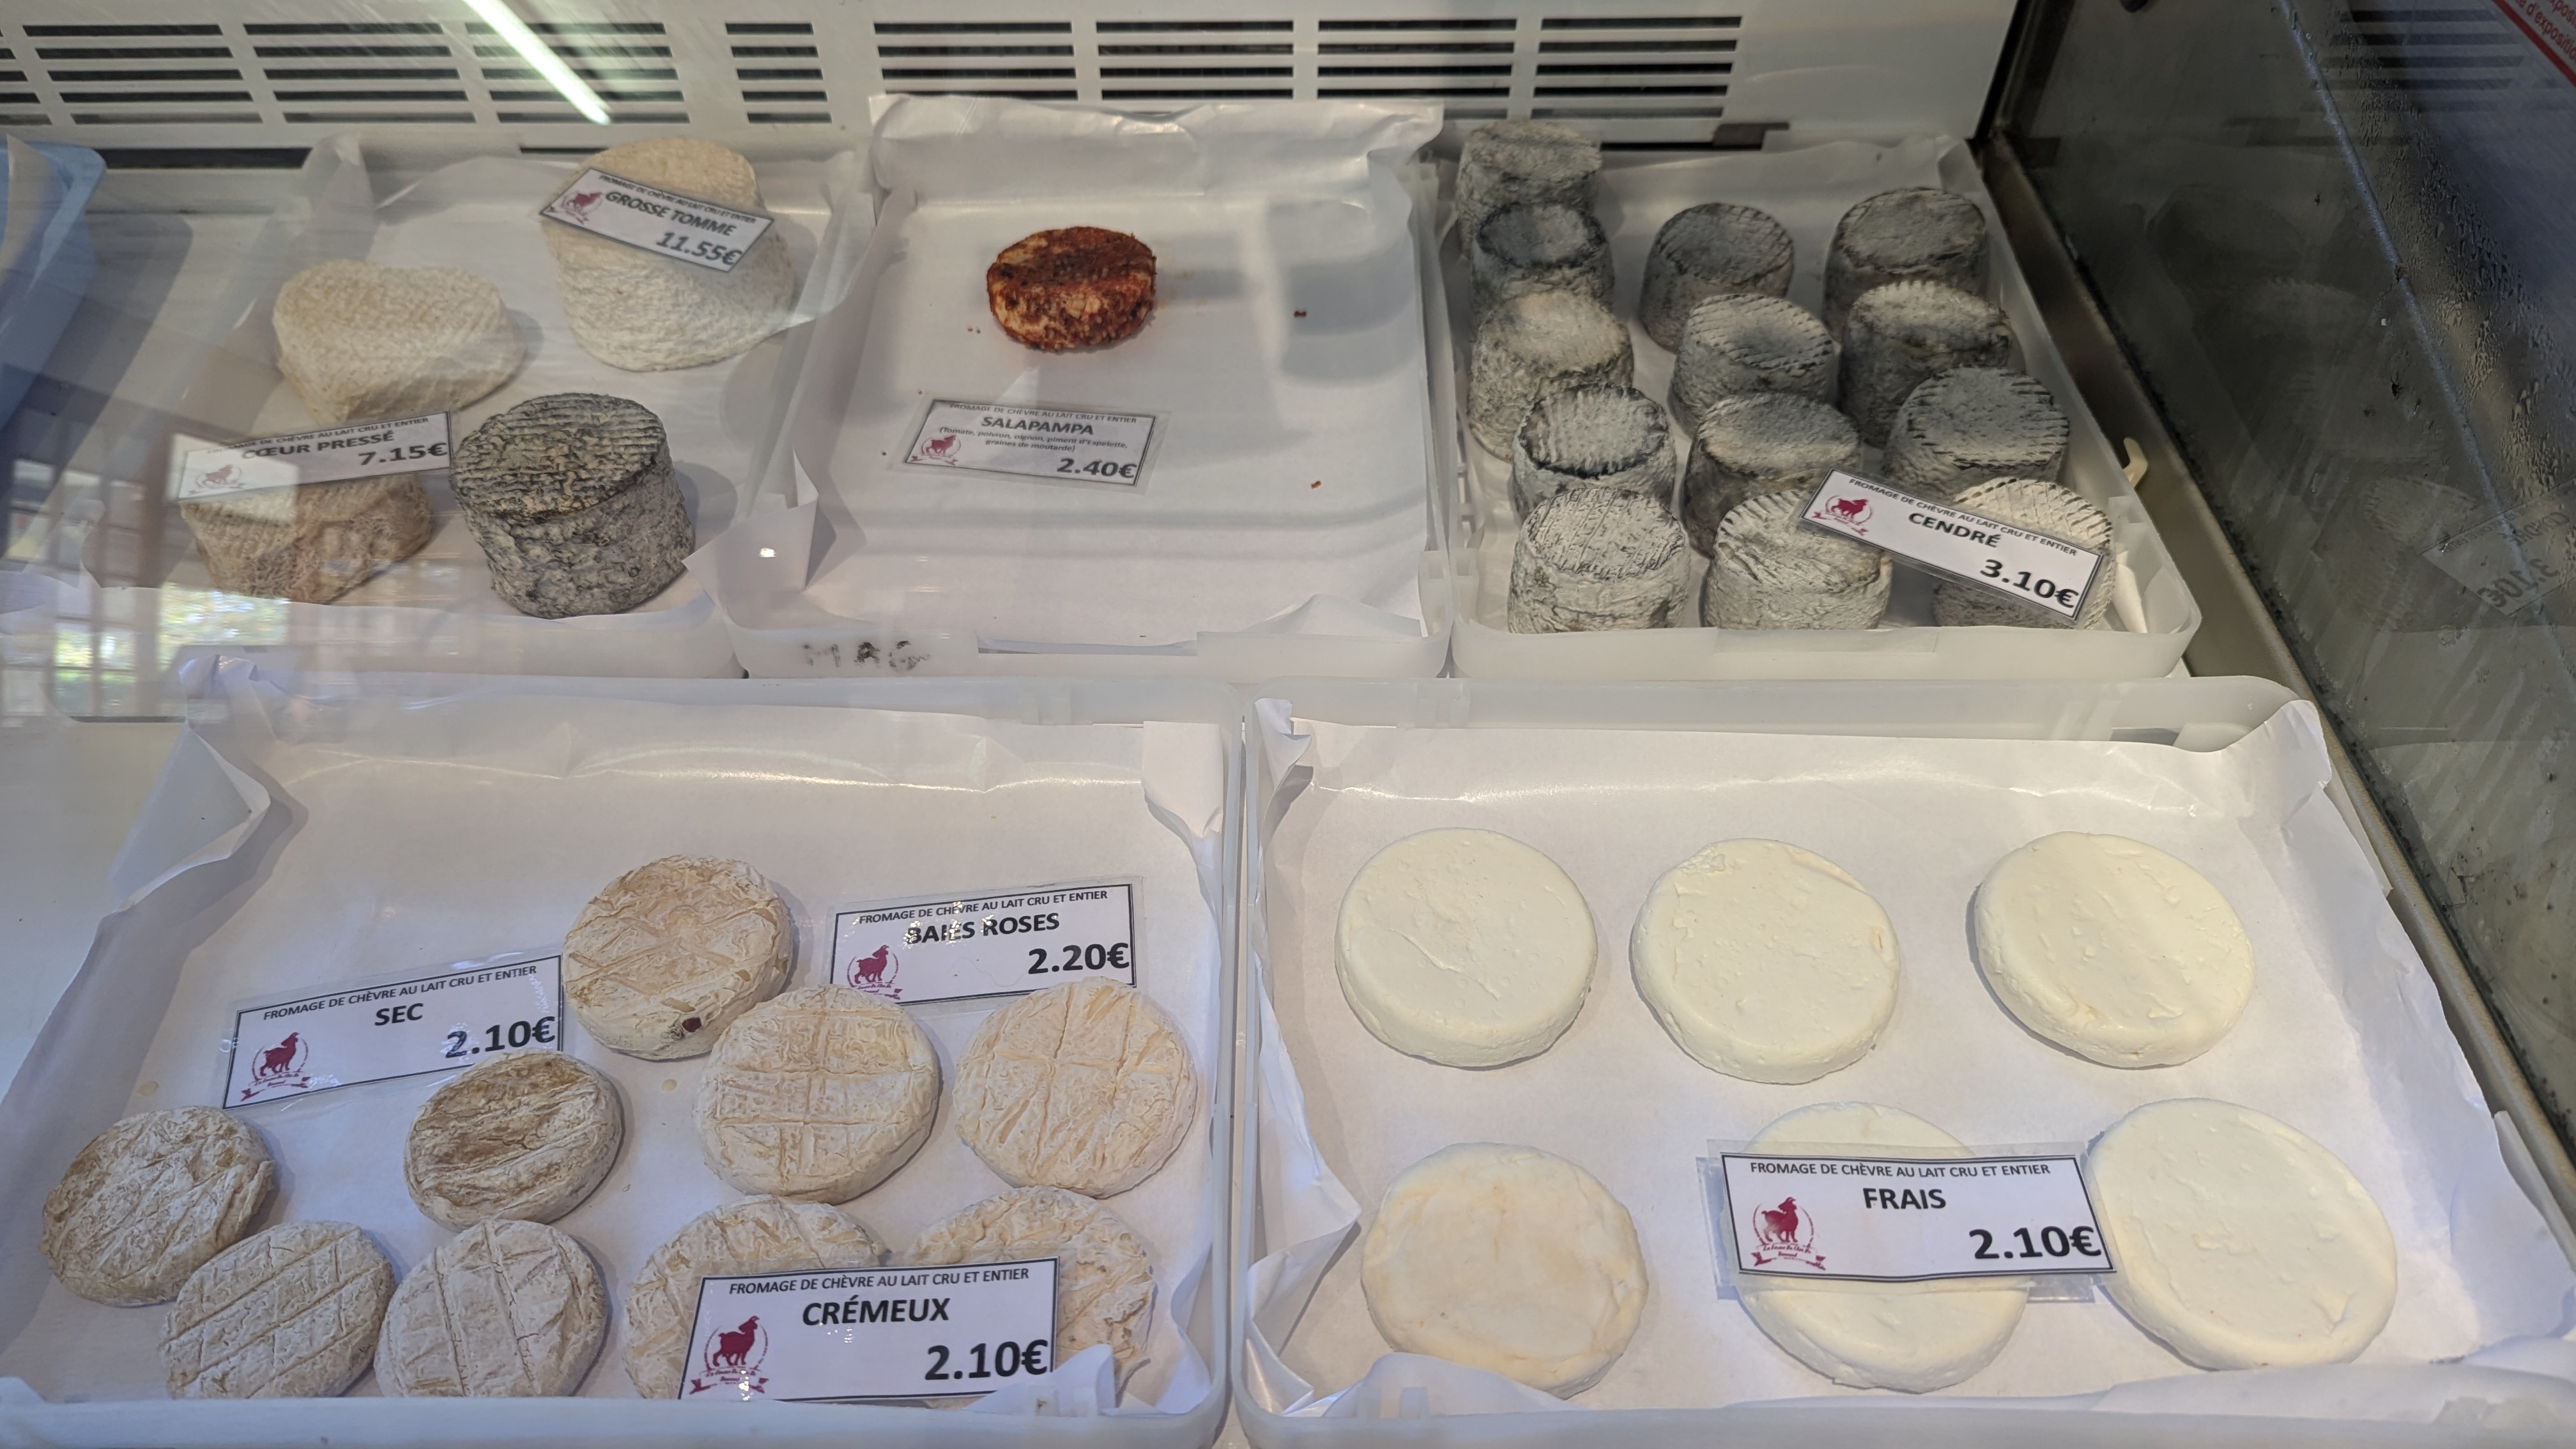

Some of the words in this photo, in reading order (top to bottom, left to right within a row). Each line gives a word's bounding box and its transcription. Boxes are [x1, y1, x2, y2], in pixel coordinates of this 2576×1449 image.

[2526, 3, 2576, 60] d'expositio
[606, 191, 670, 218] GROSSE
[671, 210, 737, 236] TOMME
[656, 231, 742, 265] 11.55€
[950, 403, 991, 411] FROMAGE
[318, 431, 394, 451] PRESSÉ
[335, 427, 356, 436] LAIT
[394, 417, 428, 427] ENTIER
[981, 417, 1093, 435] SALAPAMPA
[358, 442, 447, 466] 7.15€
[985, 439, 1016, 448] graines
[1031, 443, 1075, 452] moutarde)
[1057, 458, 1137, 479] 2.40€
[1848, 479, 1899, 500] FROMAGE
[1901, 495, 1914, 505] DE
[1916, 500, 1956, 518] CHÈVRE
[1958, 512, 1974, 522] AU
[1975, 518, 1998, 530] LAIT
[2000, 526, 2023, 537] CRU
[2040, 538, 2078, 556] ENTIER
[1908, 512, 2001, 548] CENDRÉ
[1980, 559, 2078, 608] 3.10€
[859, 910, 915, 924] FROMAGE
[918, 908, 933, 917] DE
[982, 901, 998, 910] AU
[1000, 899, 1025, 908] LAIT
[1027, 895, 1050, 905] CRU
[1054, 894, 1066, 903] ET
[1069, 891, 1107, 901] ENTIER
[907, 921, 975, 944] BAIES
[983, 913, 1059, 937] ROSES
[1028, 943, 1129, 974] 2.20€
[263, 999, 325, 1020] FROMAGE
[328, 997, 345, 1008] DE
[348, 989, 396, 1004] CHÈVRE
[399, 986, 417, 997] AU
[420, 981, 447, 992] LAIT
[449, 976, 474, 988] CRU
[478, 973, 492, 983] ET
[495, 965, 537, 979] ENTIER
[374, 1003, 424, 1026] SEC
[445, 1016, 555, 1058] 2.10€
[1750, 1162, 1817, 1175] FROMAGE
[1820, 1164, 1839, 1175] DE
[1841, 1163, 1893, 1177] CHÈVRE
[1896, 1165, 1915, 1177] AU
[1919, 1167, 1946, 1177] LAIT
[1949, 1166, 1978, 1177] CRU
[1982, 1165, 1997, 1177] ET
[2001, 1164, 2050, 1176] ENTIER
[1862, 1188, 1946, 1209] FRAIS
[1969, 1226, 2102, 1259] 2.10€
[729, 1278, 797, 1295] FROMAGE
[800, 1278, 818, 1290] DE
[820, 1275, 874, 1289] CHÈVRE
[877, 1275, 897, 1287] AU
[900, 1275, 928, 1286] LAIT
[931, 1273, 960, 1285] CRU
[963, 1271, 979, 1282] ET
[983, 1268, 1029, 1282] ENTIER
[802, 1295, 950, 1326] CRÉMEUX
[924, 1339, 1048, 1380] 2.10€
